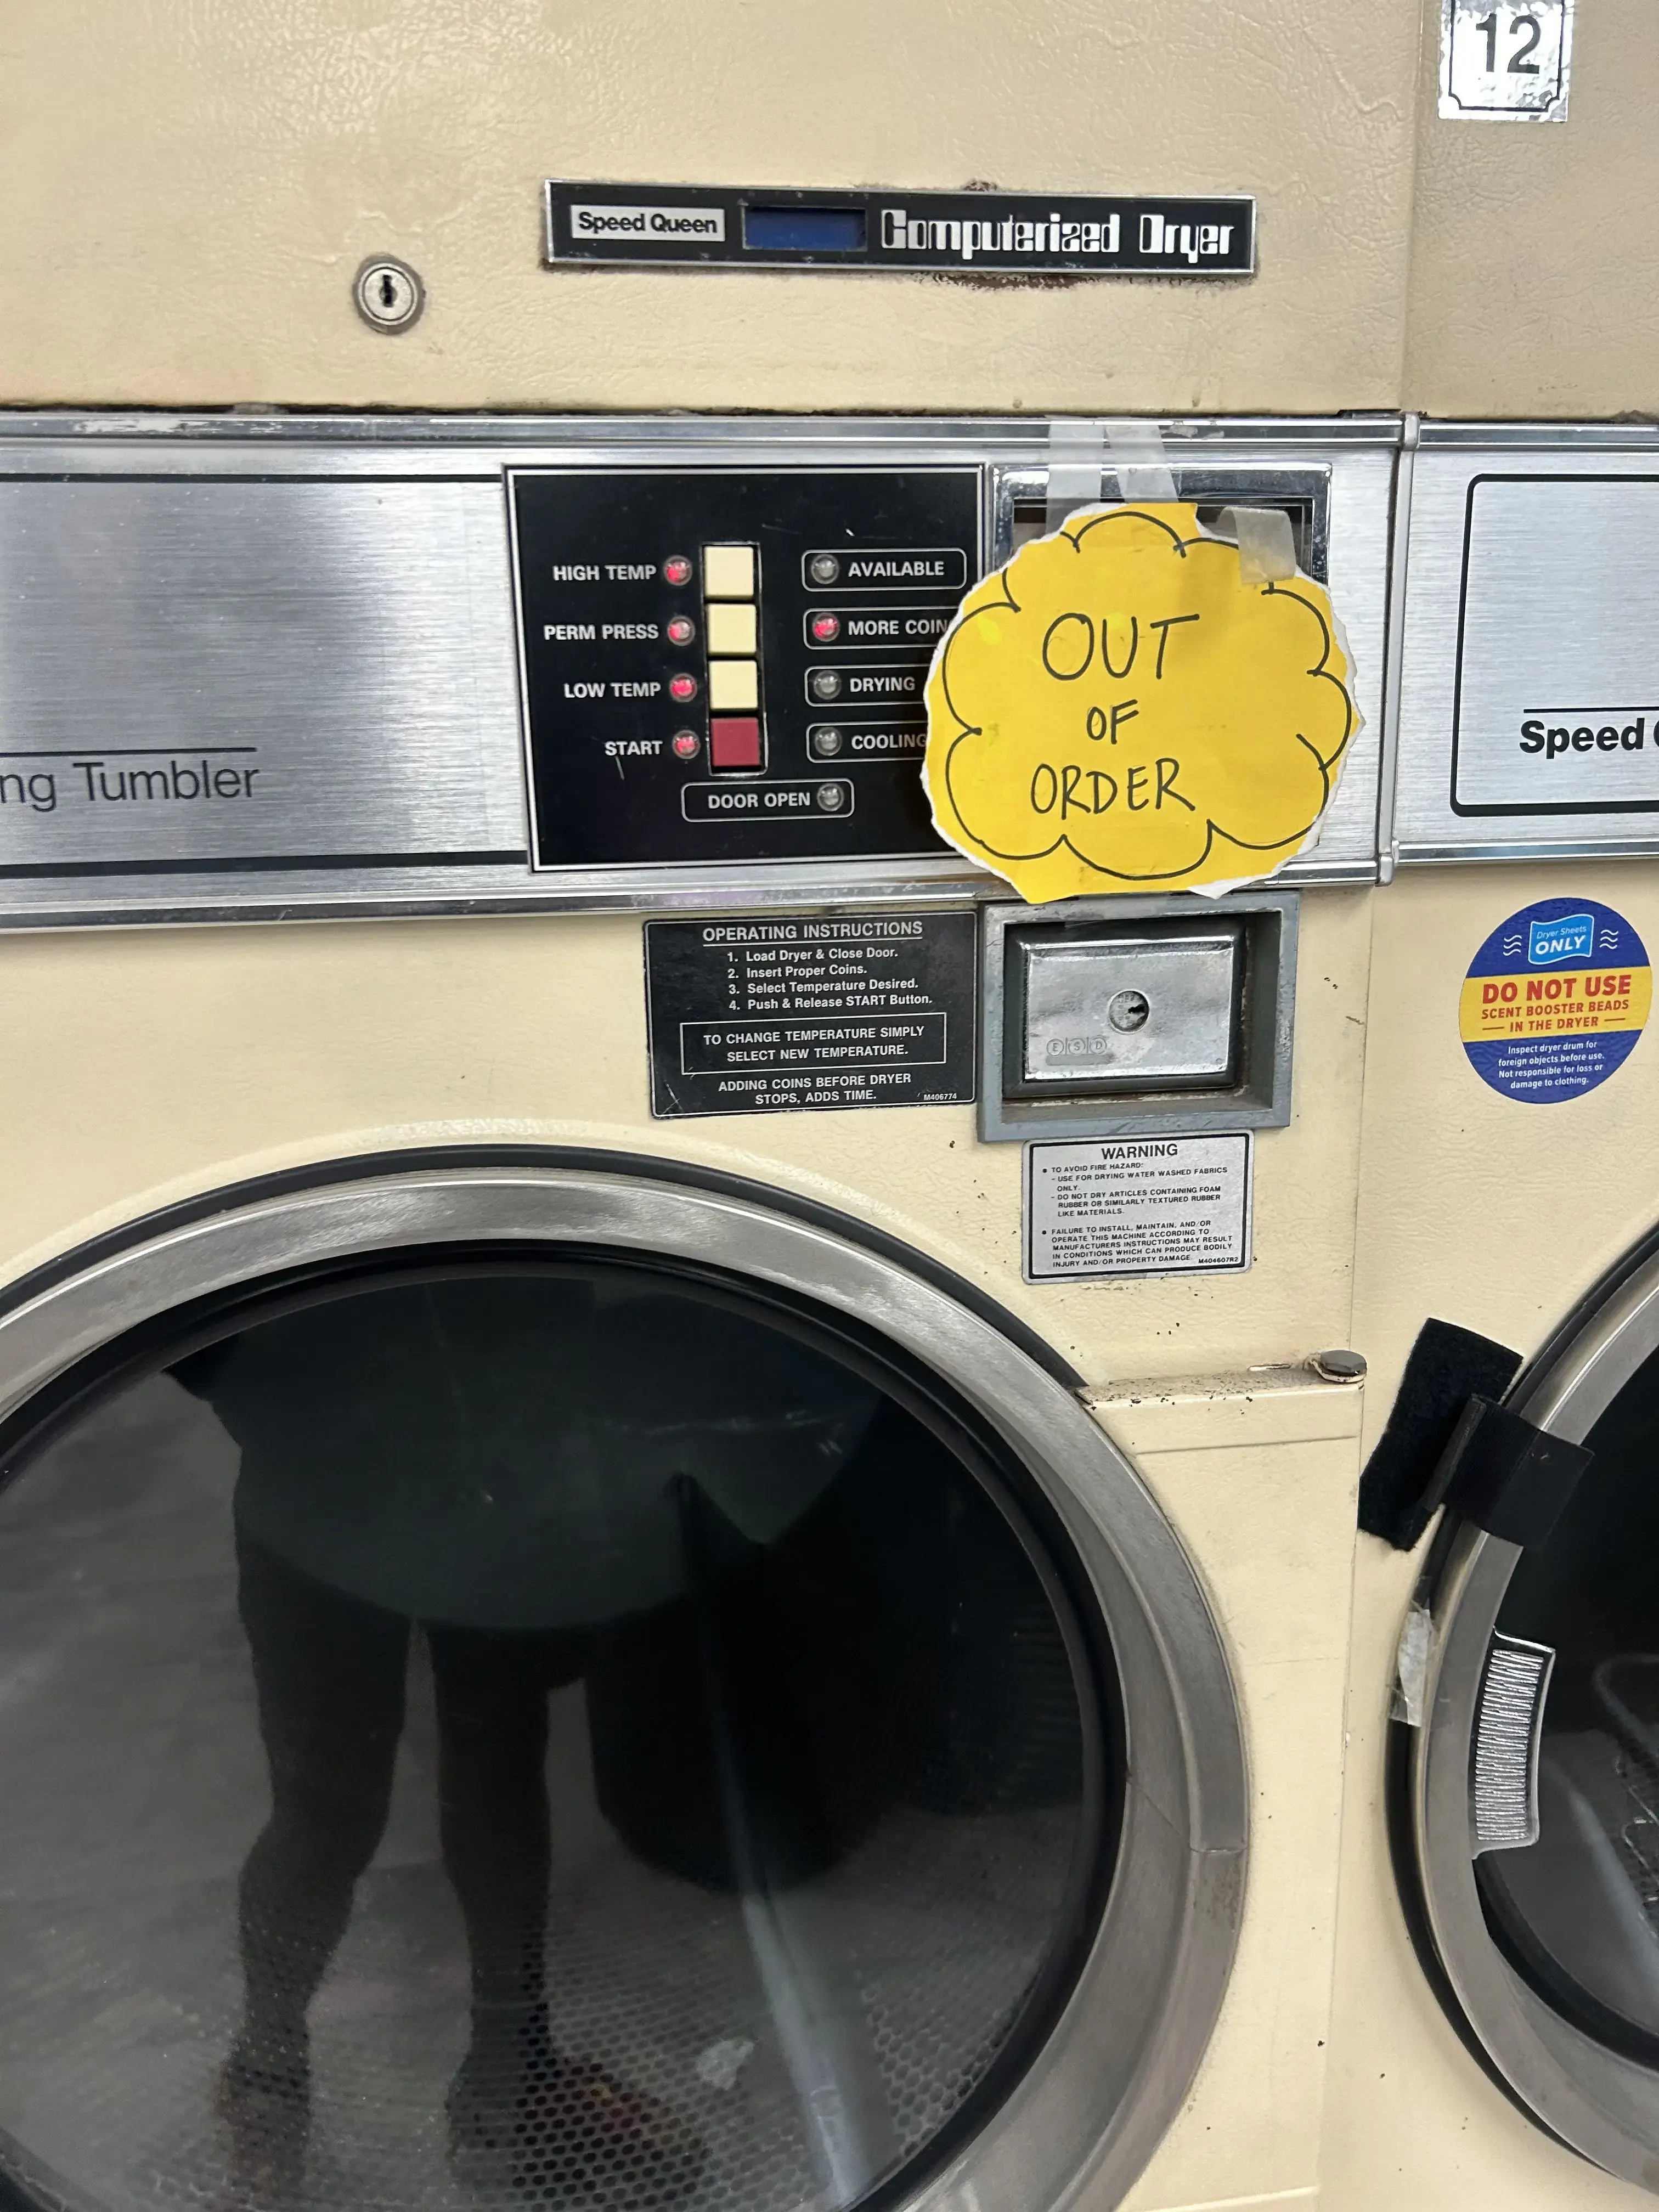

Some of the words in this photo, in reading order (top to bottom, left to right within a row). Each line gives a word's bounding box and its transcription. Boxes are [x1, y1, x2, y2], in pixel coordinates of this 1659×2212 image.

[1476, 13, 1541, 74] 12
[579, 211, 646, 233] Speed
[650, 213, 718, 234] Queen
[881, 210, 1120, 260] Computerized
[1139, 215, 1233, 263] Dryer
[553, 567, 600, 581] HIGH
[605, 566, 656, 580] TEMP
[848, 562, 944, 577] AVAILABLE
[544, 625, 596, 641] PERM
[602, 624, 659, 640] PRESS
[848, 621, 900, 636] MORE
[905, 620, 947, 635] COIN
[1042, 613, 1200, 681] OUT
[564, 683, 605, 698] LOW
[610, 682, 661, 697] TEMP
[849, 678, 916, 693] DRYING
[1086, 699, 1140, 744] OF
[851, 735, 927, 749] COOLING
[1519, 718, 1645, 759] Speed
[605, 741, 663, 757] START
[72, 759, 260, 801] Tumbler
[1030, 758, 1195, 820] ORDER
[708, 794, 758, 810] DOOR
[764, 792, 810, 808] OPEN
[703, 925, 797, 941] OPERATING
[804, 921, 923, 938] INSTRUCTIONS
[1537, 930, 1559, 939] Dryer
[1560, 926, 1587, 935] Sheets
[1536, 935, 1585, 955] ONLY
[727, 952, 738, 962] 1.
[746, 950, 777, 961] Load
[780, 949, 812, 962] Dryer
[815, 949, 825, 960] &
[828, 948, 864, 960] Close
[866, 946, 898, 958] Door.
[727, 969, 739, 979] 2.
[746, 967, 782, 978] Insert
[785, 966, 826, 979] Proper
[829, 963, 867, 975] Coins.
[729, 984, 740, 994] 3.
[747, 982, 786, 994] Select
[789, 980, 866, 994] Temperature
[869, 978, 918, 990] Desired.
[1482, 982, 1517, 1003] DO
[1526, 978, 1577, 1001] NOT
[1585, 975, 1632, 996] USE
[729, 1000, 740, 1011] 4.
[748, 998, 778, 1010] Push
[782, 997, 791, 1008] &
[795, 995, 843, 1008] Release
[846, 994, 885, 1006] START
[889, 993, 933, 1005] Button.
[1482, 1007, 1521, 1019] SCENT
[1526, 1003, 1583, 1017] BOOSTER
[1588, 1000, 1629, 1012] BEADS
[1510, 1022, 1522, 1032] IN
[1528, 1019, 1551, 1030] THE
[1557, 1017, 1599, 1029] DRYER
[703, 1035, 721, 1046] TO
[726, 1032, 780, 1045] CHANGE
[785, 1028, 876, 1042] TEMPERATURE
[880, 1026, 925, 1038] SIMPLY
[726, 1050, 776, 1062] SELECT
[780, 1048, 810, 1060] NEW
[814, 1045, 909, 1059] TEMPERATURE.
[1508, 1045, 1538, 1055] Inspect
[1539, 1044, 1561, 1053] dryer
[1498, 1059, 1527, 1067] foreign
[1529, 1056, 1558, 1065] objects
[1515, 1066, 1561, 1077] responsible
[719, 1080, 767, 1092] ADDING
[771, 1078, 811, 1090] COINS
[816, 1076, 865, 1087] BEFORE
[870, 1074, 911, 1085] DRYER
[1511, 1080, 1542, 1089] damage
[1555, 1076, 1589, 1085] clothing.
[755, 1093, 801, 1106] STOPS,
[805, 1092, 840, 1103] ADDS
[844, 1090, 877, 1101] TIME.
[1101, 1144, 1178, 1160] WARNING
[1053, 1242, 1121, 1251] MANUFACTURERS
[1124, 1239, 1181, 1247] INSTRUCTIONS
